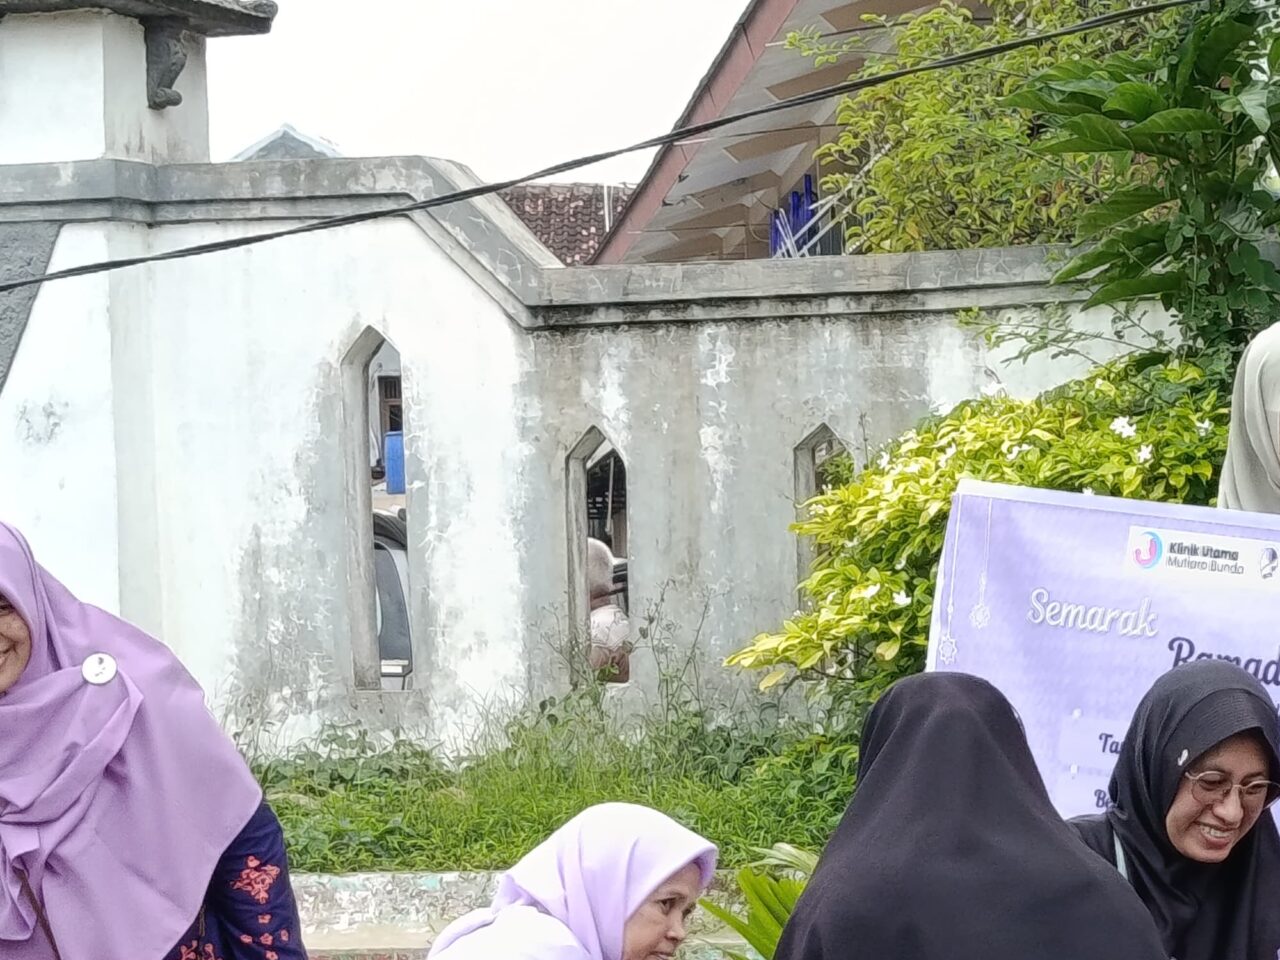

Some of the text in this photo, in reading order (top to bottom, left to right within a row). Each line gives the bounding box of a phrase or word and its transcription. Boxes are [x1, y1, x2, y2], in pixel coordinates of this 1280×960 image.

[1169, 541, 1239, 562] Klinik Utama
[1028, 588, 1158, 638] Semarak
